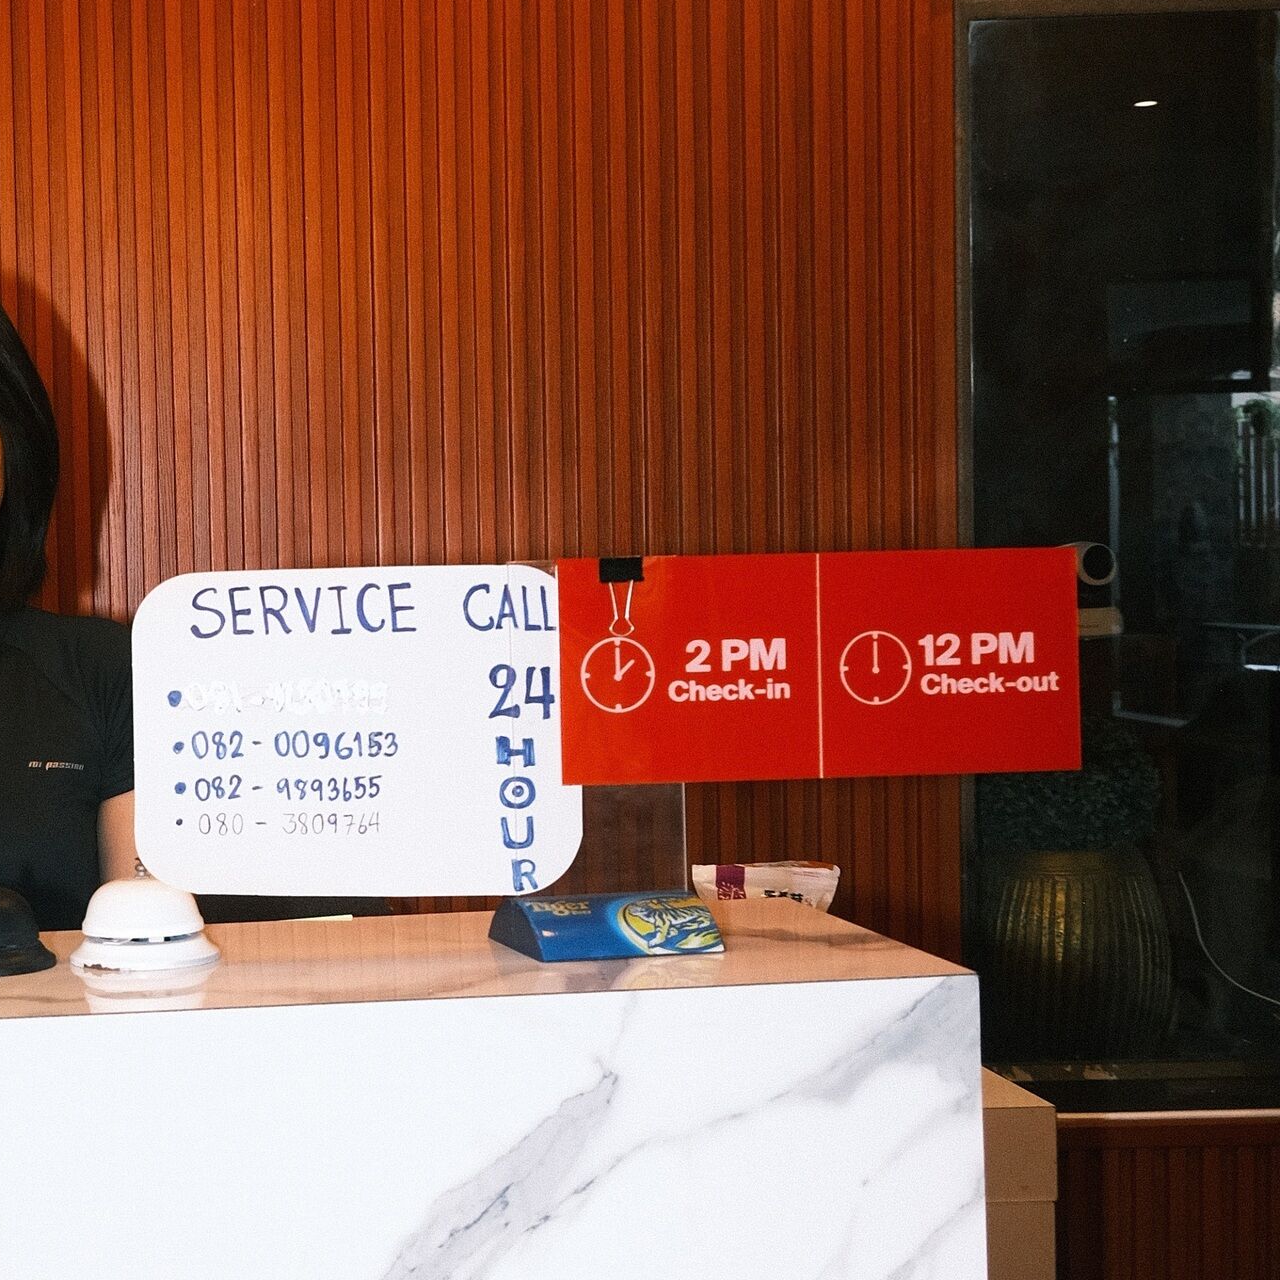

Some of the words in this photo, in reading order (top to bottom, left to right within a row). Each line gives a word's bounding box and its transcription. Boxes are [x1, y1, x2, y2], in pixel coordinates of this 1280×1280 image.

[190, 582, 417, 639] SERVICE
[462, 582, 557, 634] CALL
[685, 639, 711, 673] 2
[722, 637, 787, 673] PM
[918, 632, 961, 667] 12
[970, 631, 1035, 665] PM
[487, 663, 556, 720] 24
[667, 677, 791, 703] Check-in
[920, 670, 1060, 696] Check-out
